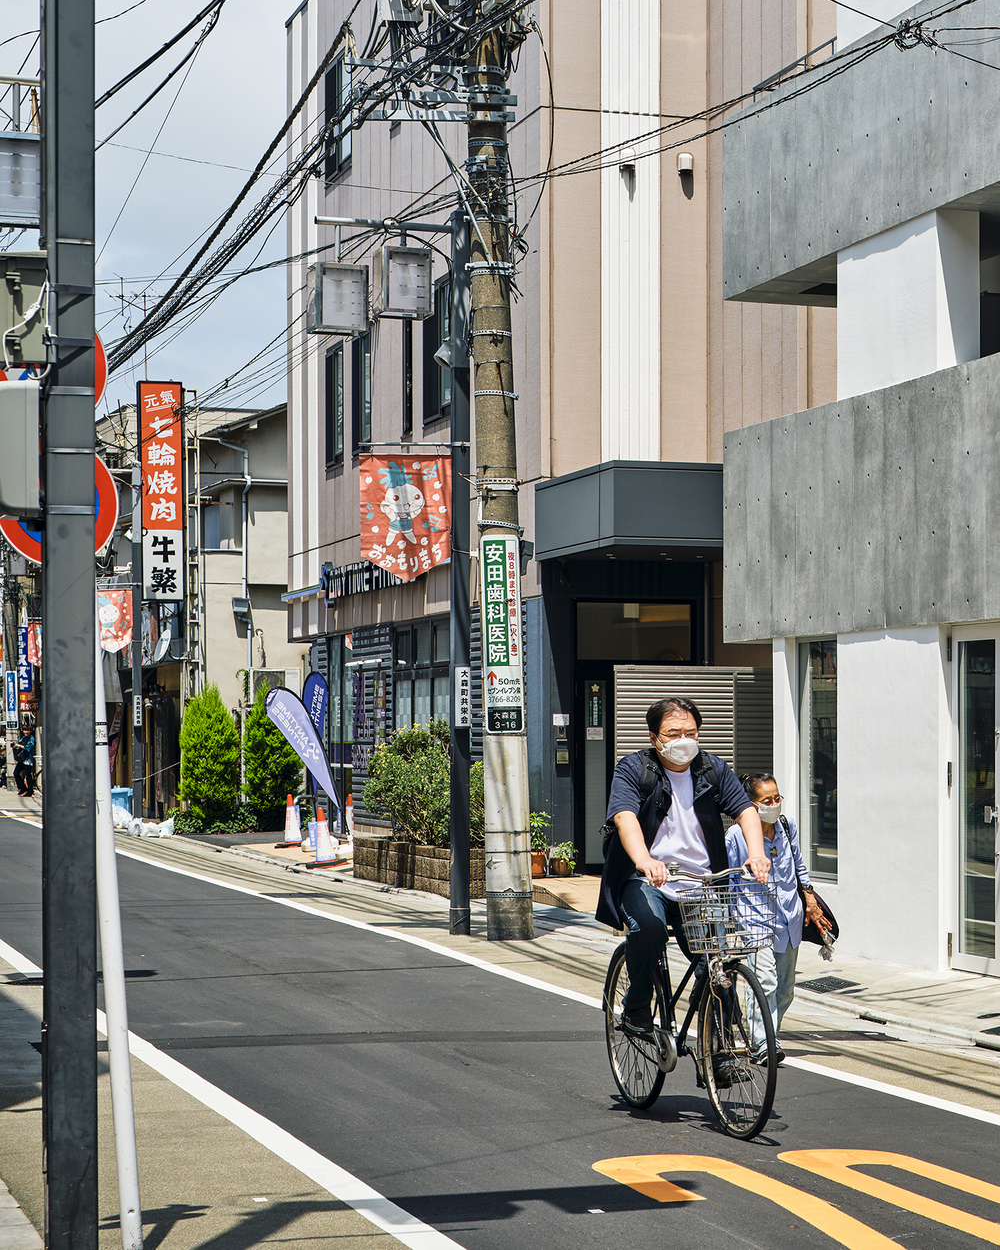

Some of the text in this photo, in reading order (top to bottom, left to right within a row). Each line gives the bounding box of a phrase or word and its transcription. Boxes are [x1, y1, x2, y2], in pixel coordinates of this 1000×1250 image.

[147, 416, 178, 523] 七輪焼肉
[150, 535, 178, 594] 牛繁
[368, 543, 443, 573] おおもりまち
[485, 543, 508, 664] 安田歯科医院
[460, 670, 469, 724] 大森町共栄会
[488, 696, 521, 704] 3766-8209
[494, 721, 517, 729] 3-16
